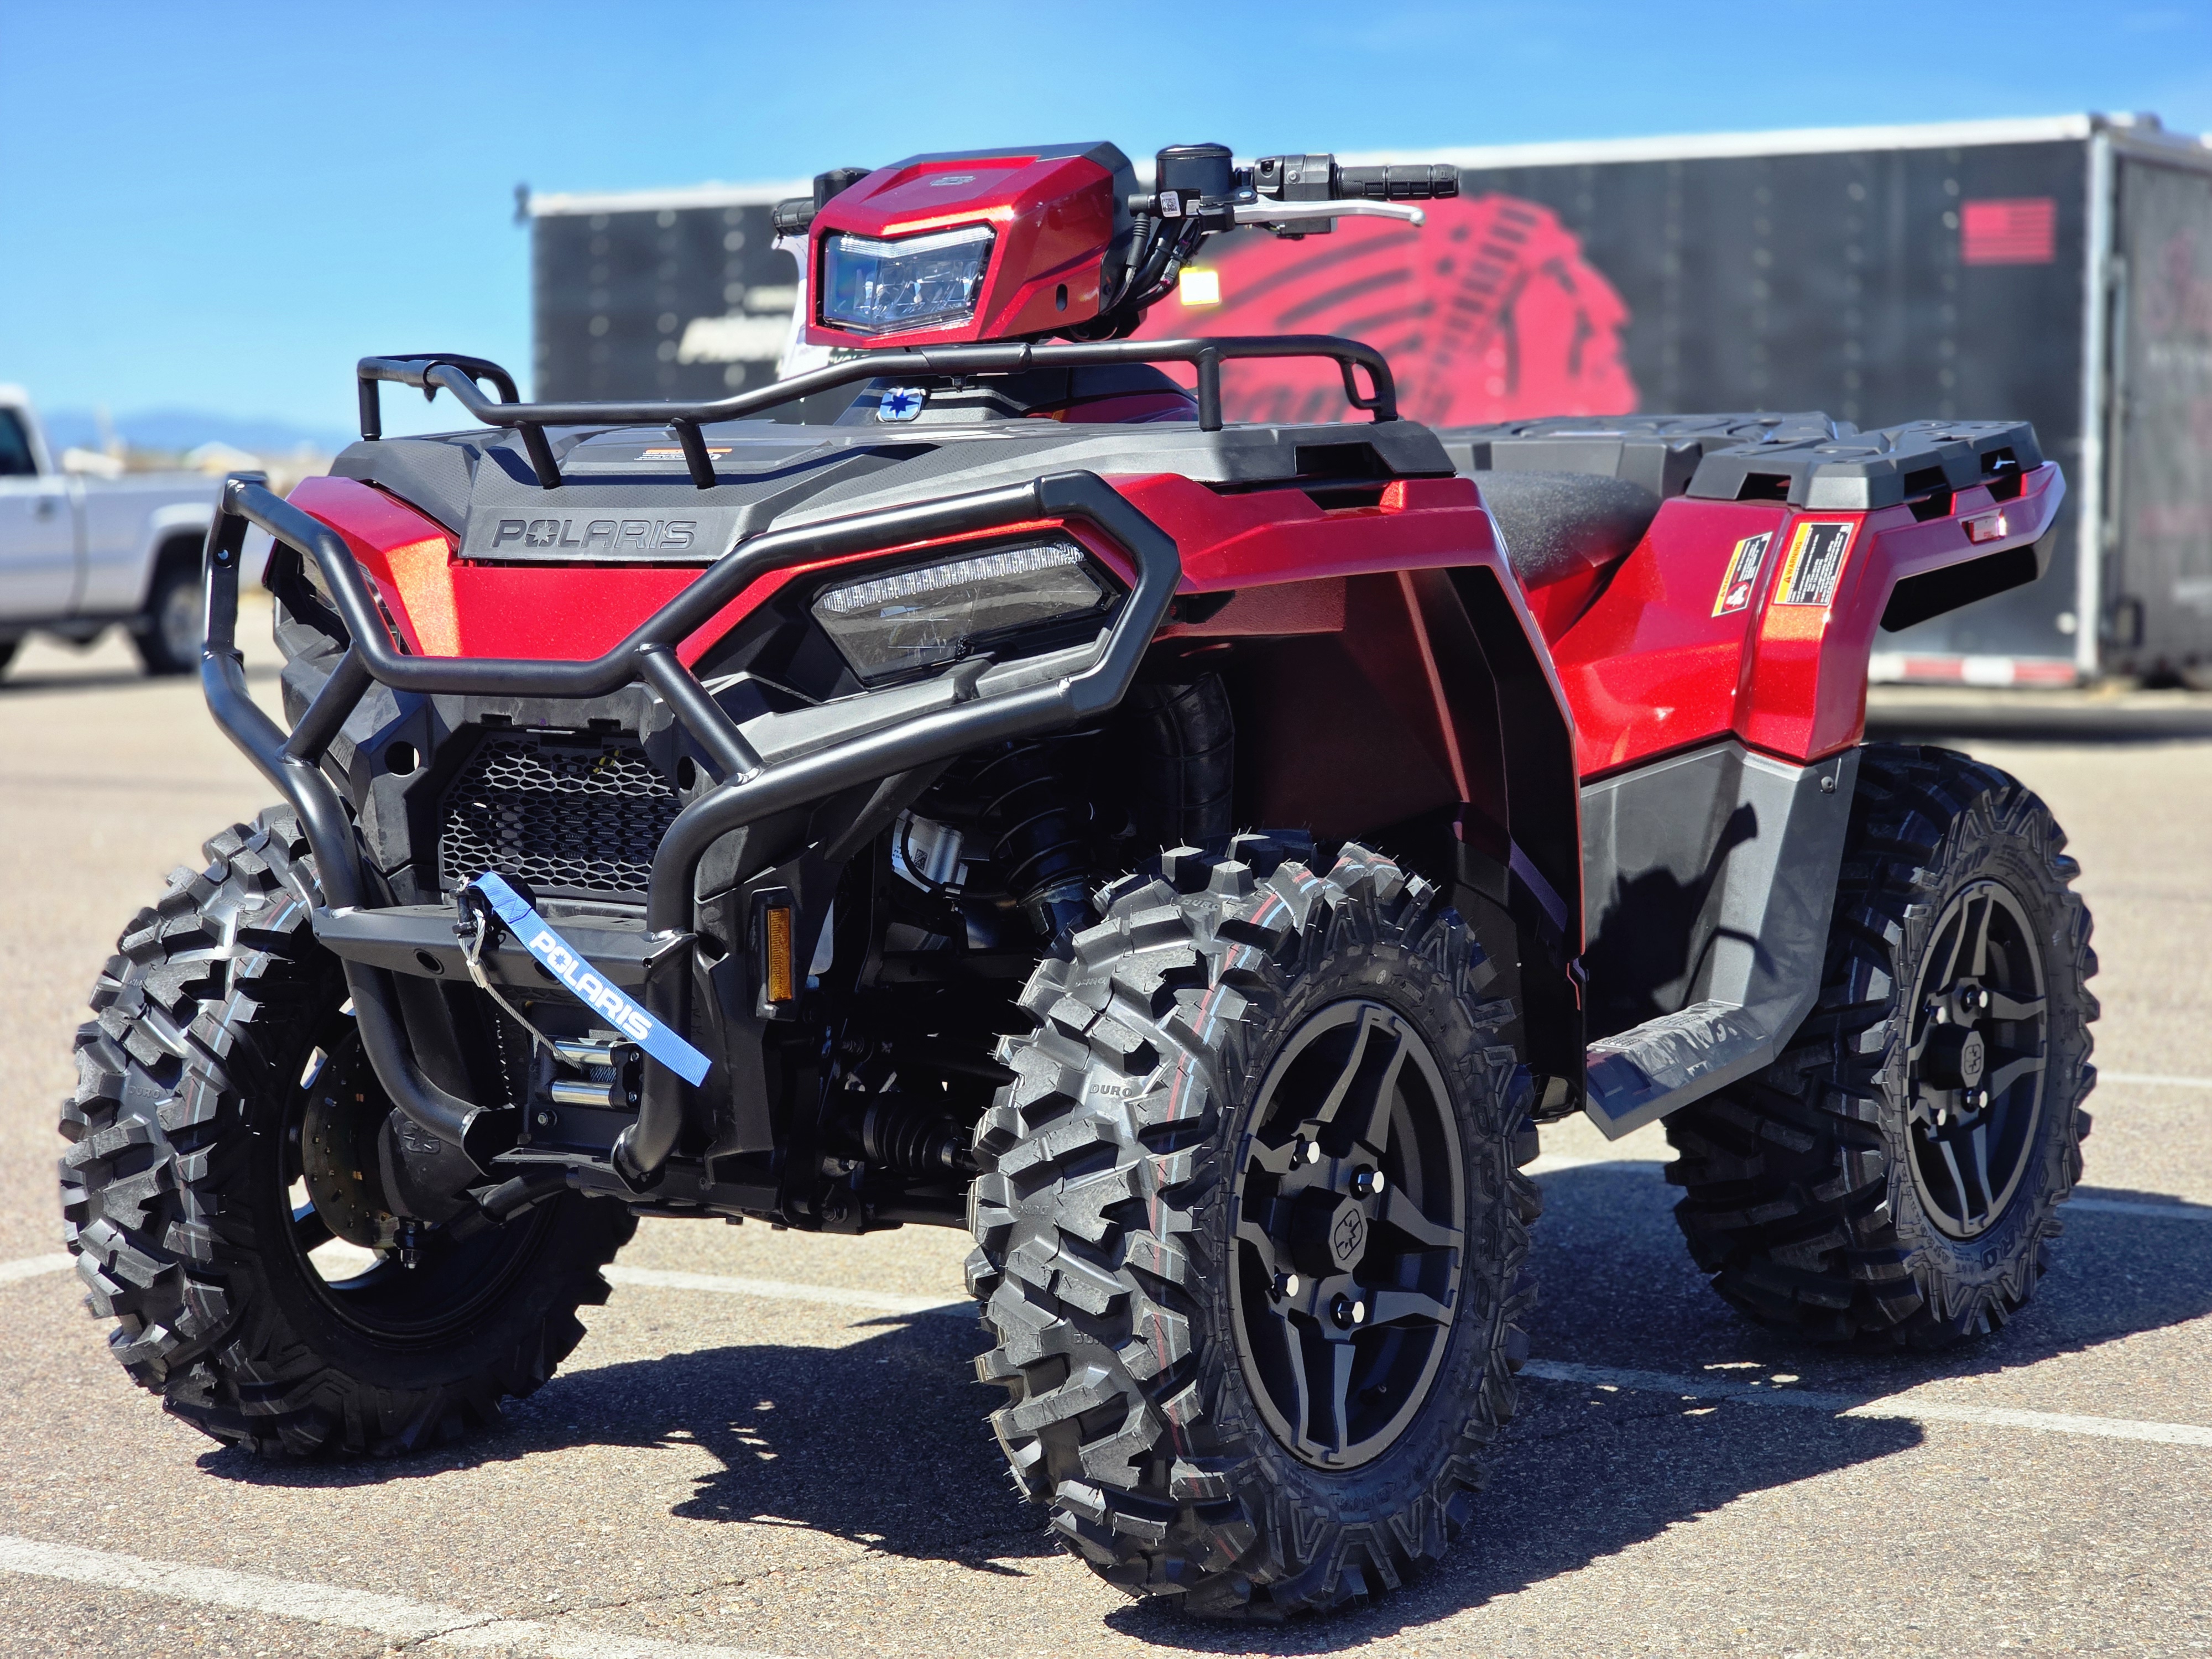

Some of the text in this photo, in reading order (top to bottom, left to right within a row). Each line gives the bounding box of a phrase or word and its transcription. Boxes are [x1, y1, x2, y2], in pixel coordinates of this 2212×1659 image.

[491, 519, 697, 549] POLARIS
[1787, 541, 1803, 575] WARNING
[1180, 899, 1221, 910] DURO
[529, 930, 653, 1041] POLARIS
[128, 1085, 161, 1099] DURO
[1089, 1083, 1133, 1097] DURO
[1471, 1102, 1500, 1322] DURO
[1981, 1159, 2049, 1271] DURO
